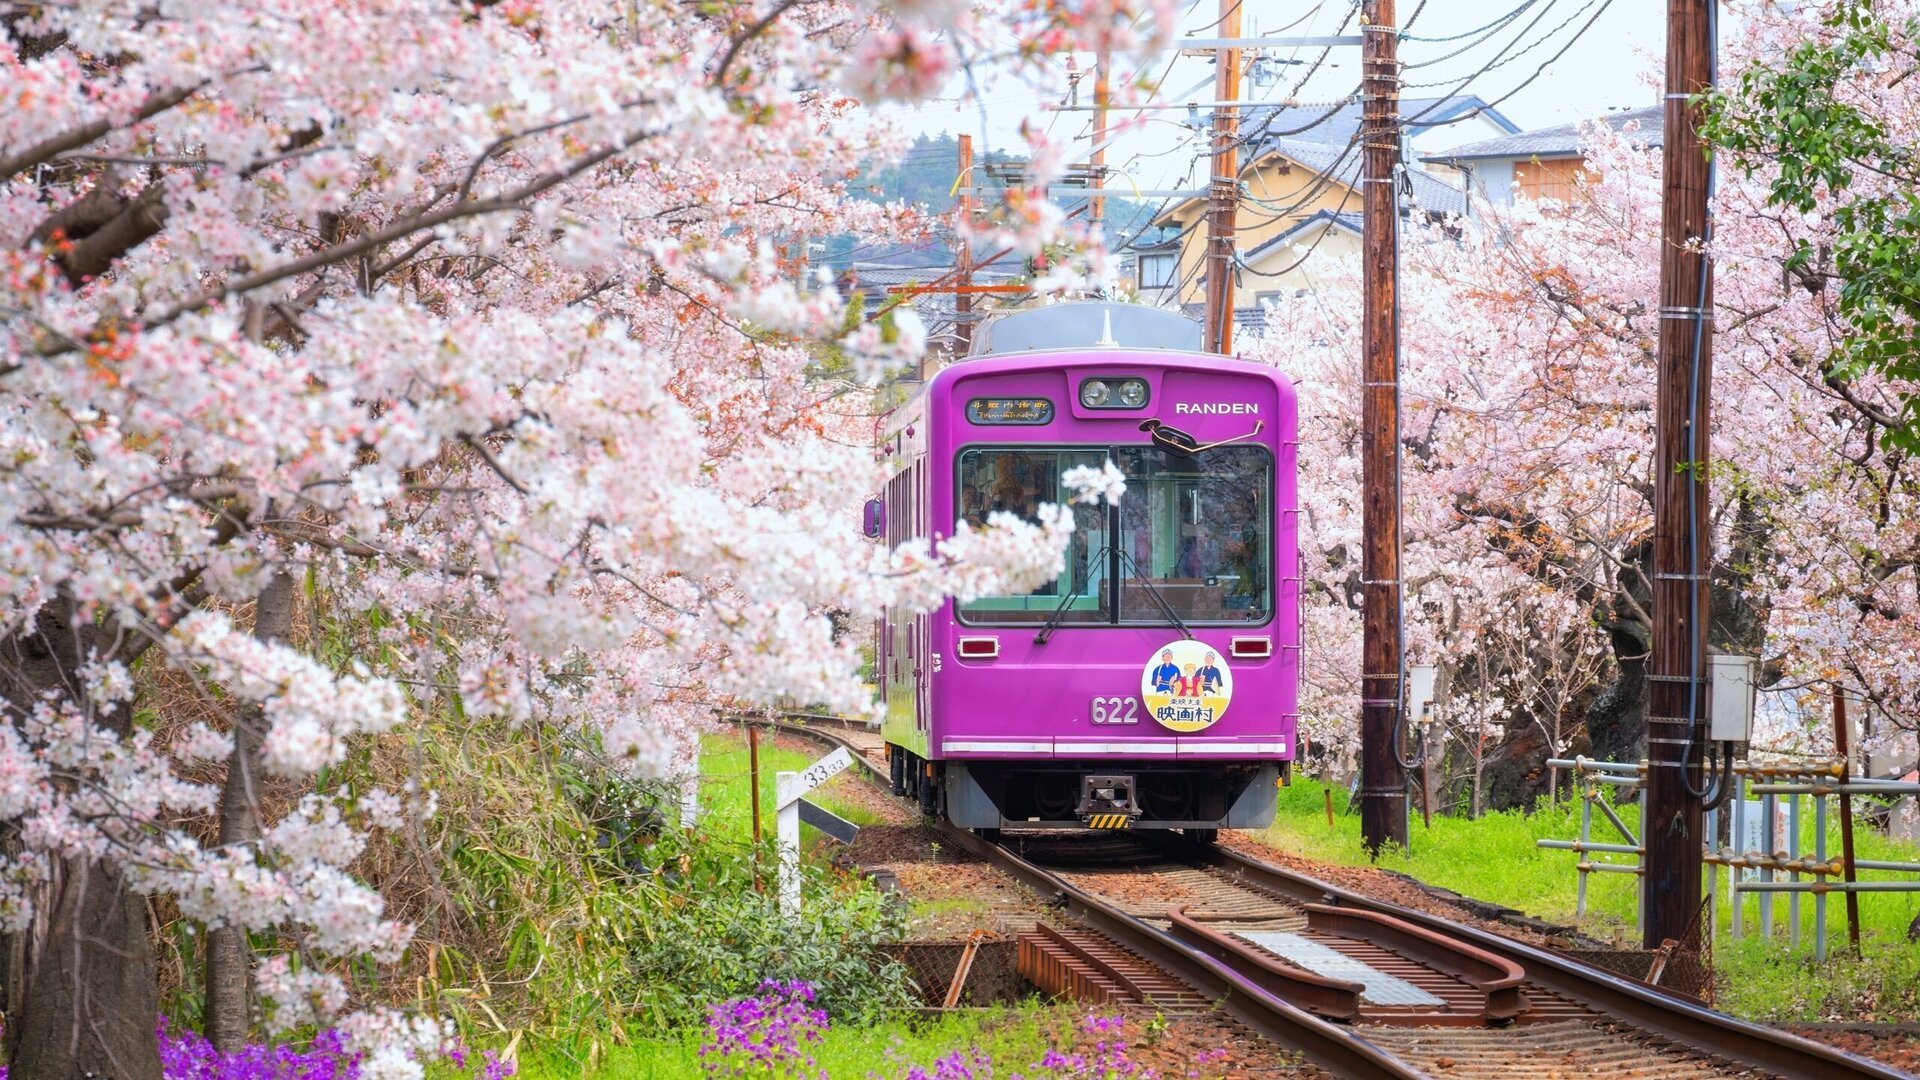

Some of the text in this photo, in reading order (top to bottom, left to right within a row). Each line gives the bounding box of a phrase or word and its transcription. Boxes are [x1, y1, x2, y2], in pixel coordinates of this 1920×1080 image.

[1176, 403, 1258, 414] RANDEN
[1092, 697, 1138, 723] 622
[1157, 706, 1214, 722] 映画村
